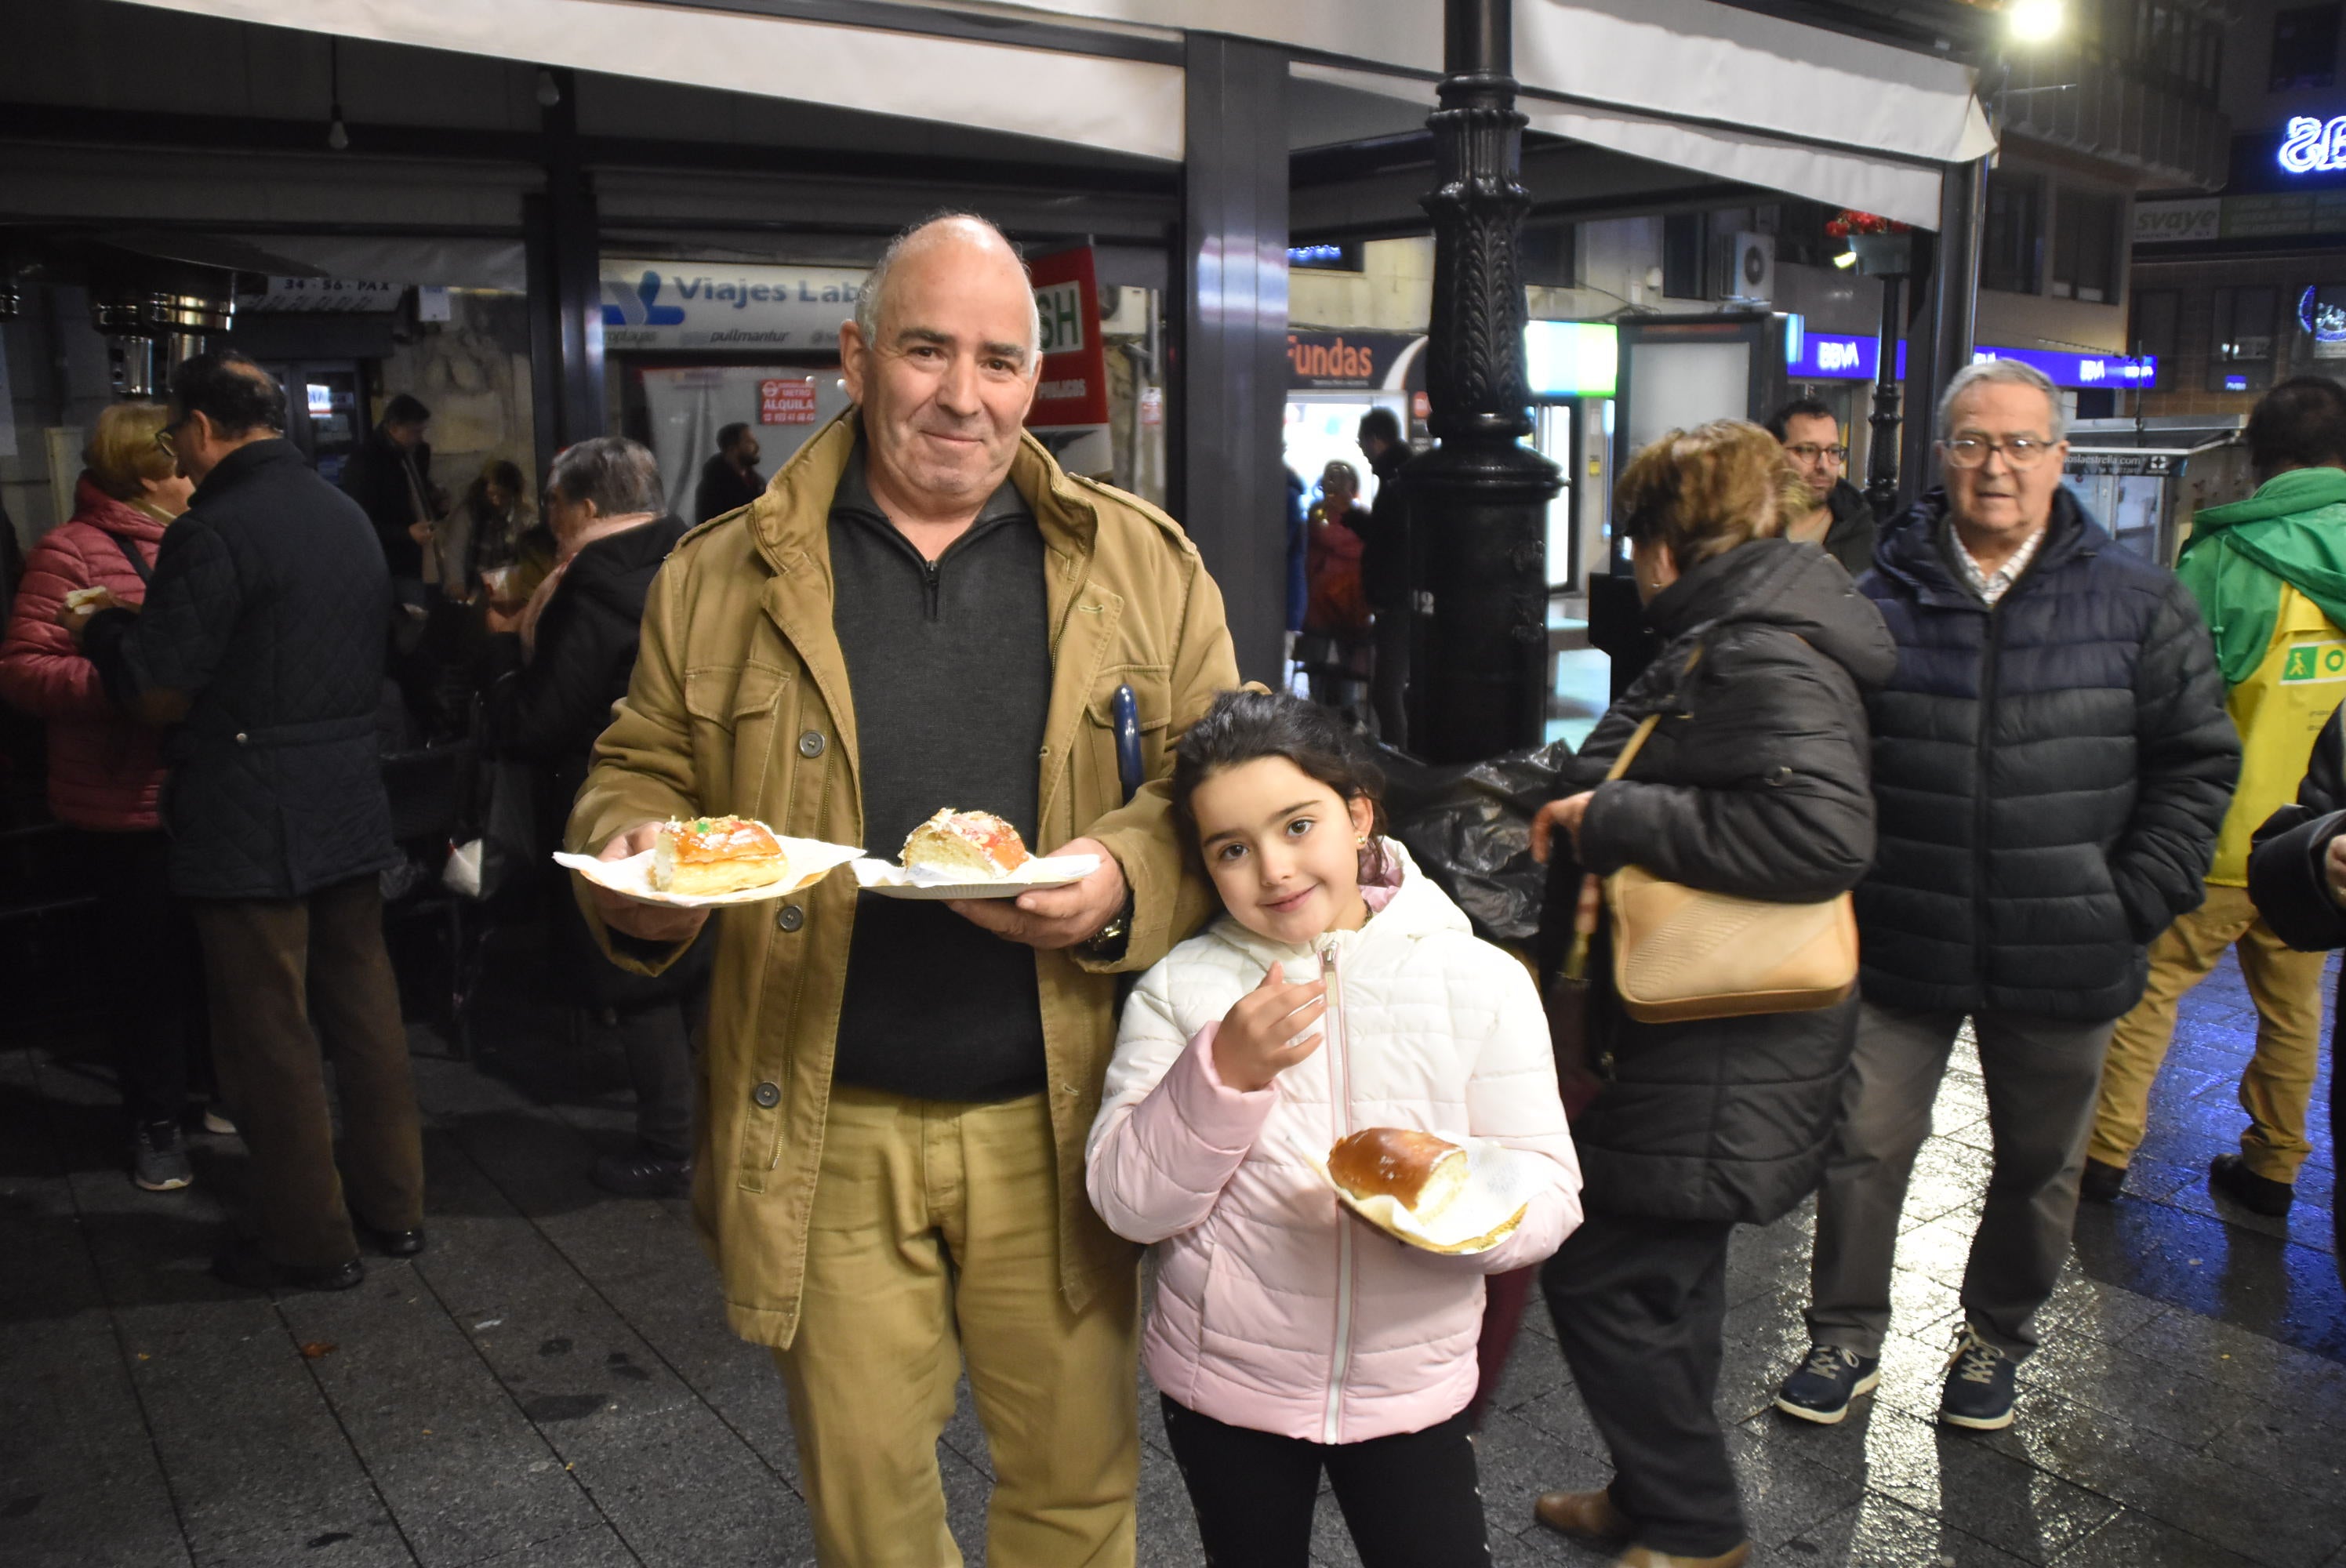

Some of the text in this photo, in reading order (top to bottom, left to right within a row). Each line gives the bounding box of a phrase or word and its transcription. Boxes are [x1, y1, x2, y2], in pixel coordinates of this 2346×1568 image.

[673, 276, 788, 308] Viajes
[710, 329, 790, 343] pullmantur
[1818, 341, 1859, 370] BBVA
[764, 399, 814, 410] ALQUILA
